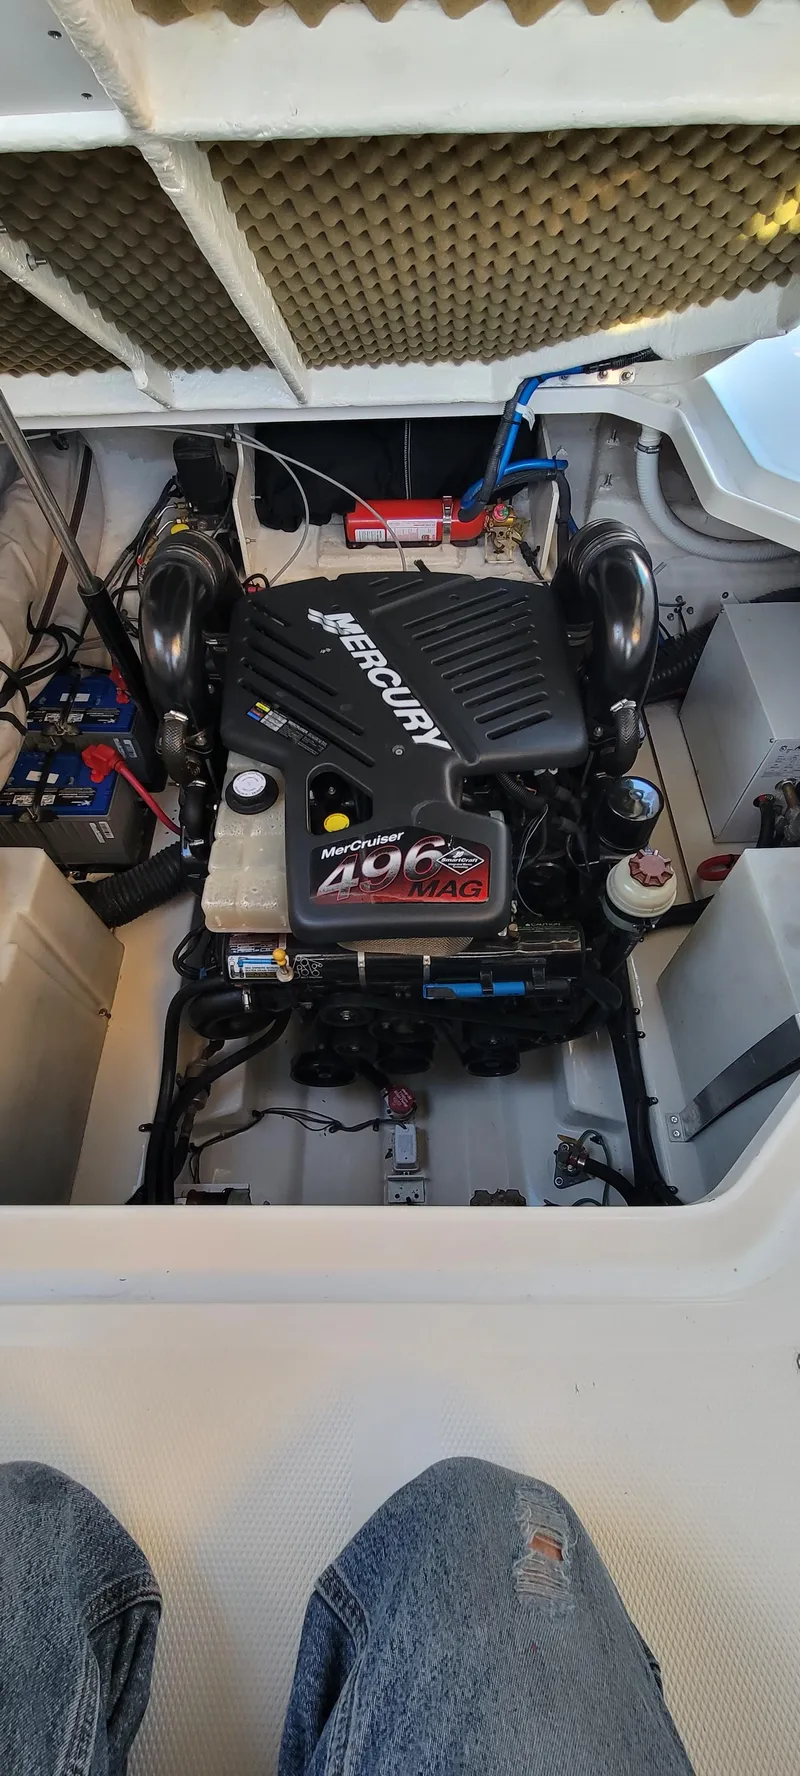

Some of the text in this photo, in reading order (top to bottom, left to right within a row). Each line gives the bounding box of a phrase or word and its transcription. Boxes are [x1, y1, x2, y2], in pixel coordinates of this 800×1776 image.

[308, 608, 452, 750] MERCURY
[316, 835, 483, 901] 496 MAG
[321, 832, 404, 860] MerCruiser
